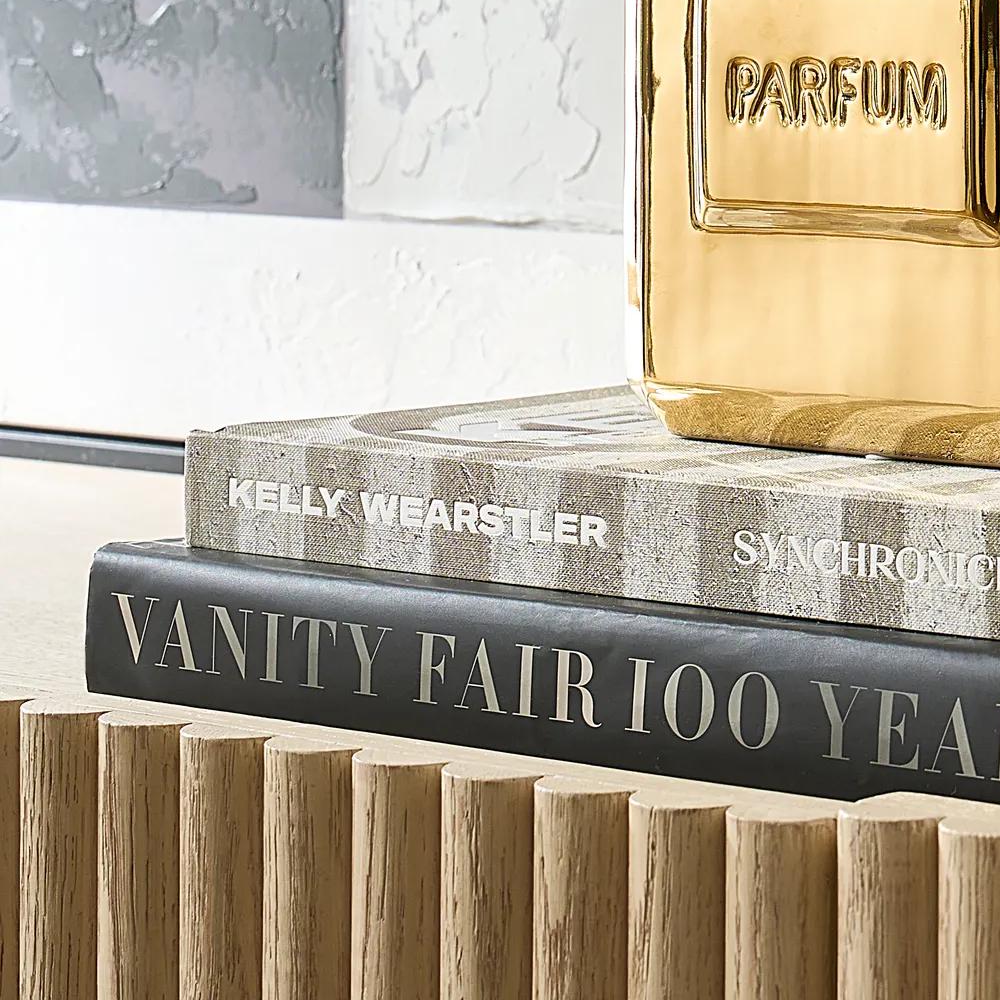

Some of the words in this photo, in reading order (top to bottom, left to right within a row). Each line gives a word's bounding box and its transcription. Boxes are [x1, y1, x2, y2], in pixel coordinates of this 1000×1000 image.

[725, 56, 948, 130] PARFUM
[227, 479, 346, 519] KELLY
[359, 491, 608, 549] WEARSTLER
[110, 592, 392, 696] VANITY
[413, 631, 602, 729] FAIR
